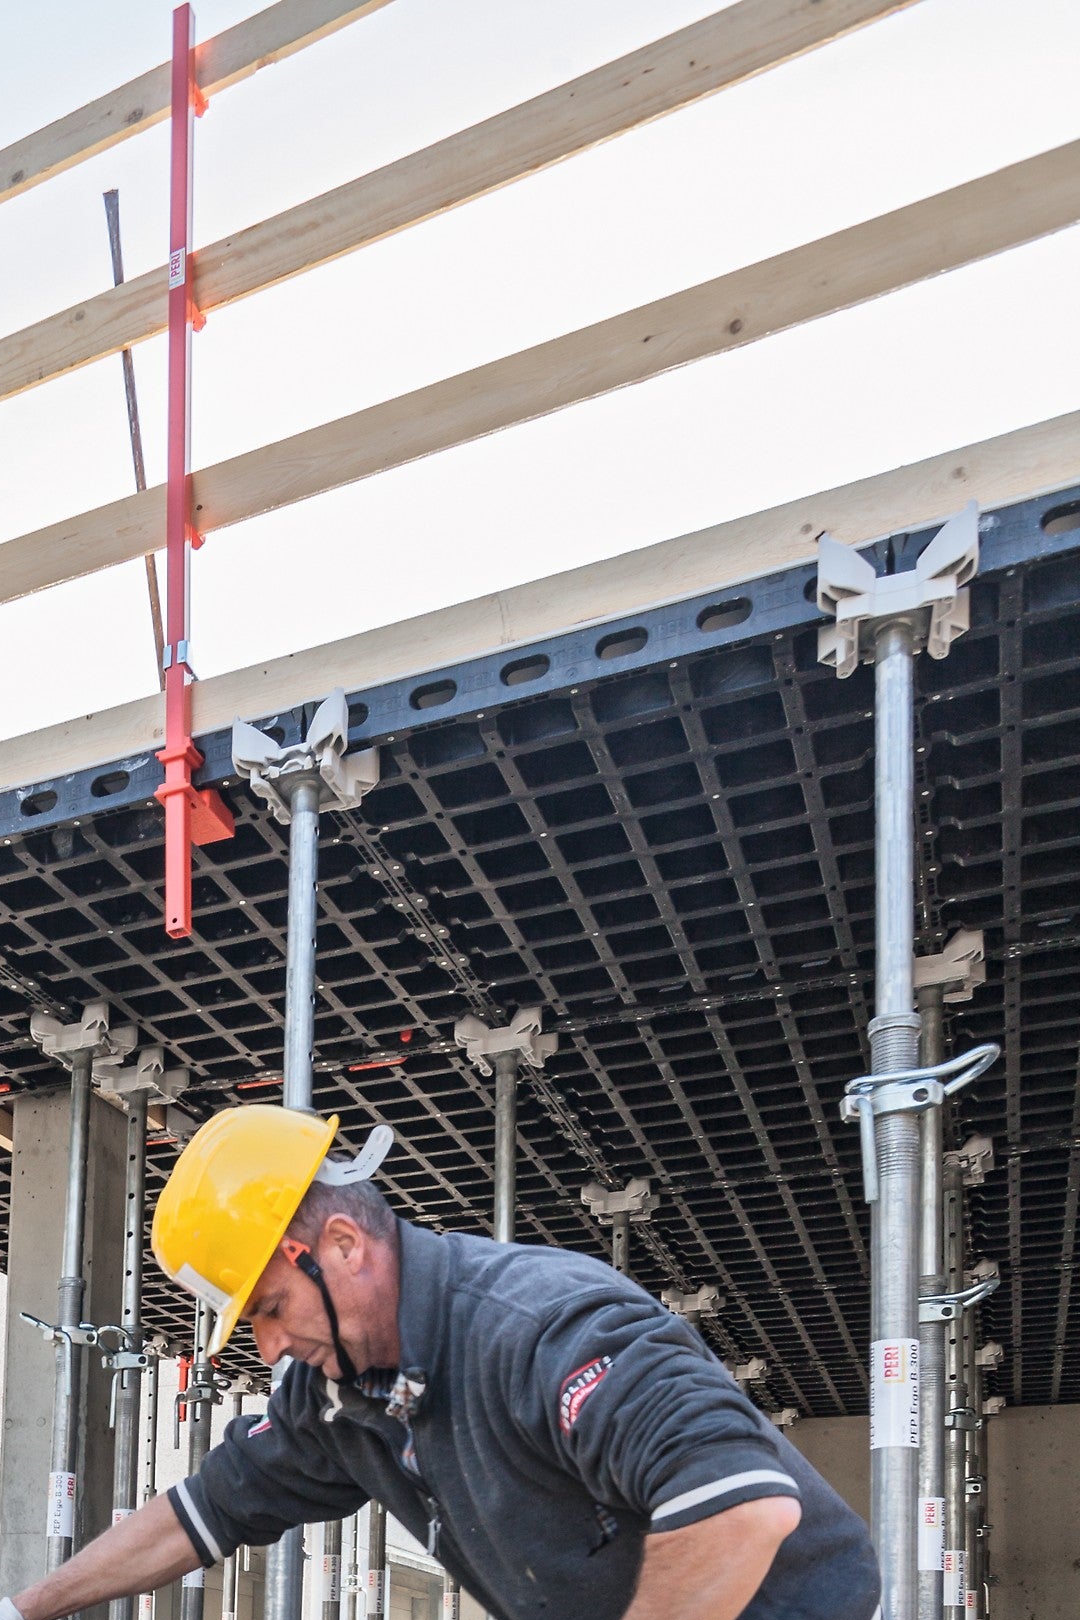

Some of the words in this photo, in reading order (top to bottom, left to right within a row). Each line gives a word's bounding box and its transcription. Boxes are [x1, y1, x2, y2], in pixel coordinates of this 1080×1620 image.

[171, 254, 181, 278] PERI
[884, 1346, 899, 1378] PERI
[910, 1419, 918, 1444] PEP
[54, 1499, 63, 1517] Ergo
[925, 1502, 935, 1523] PERI
[53, 1519, 61, 1534] PEP
